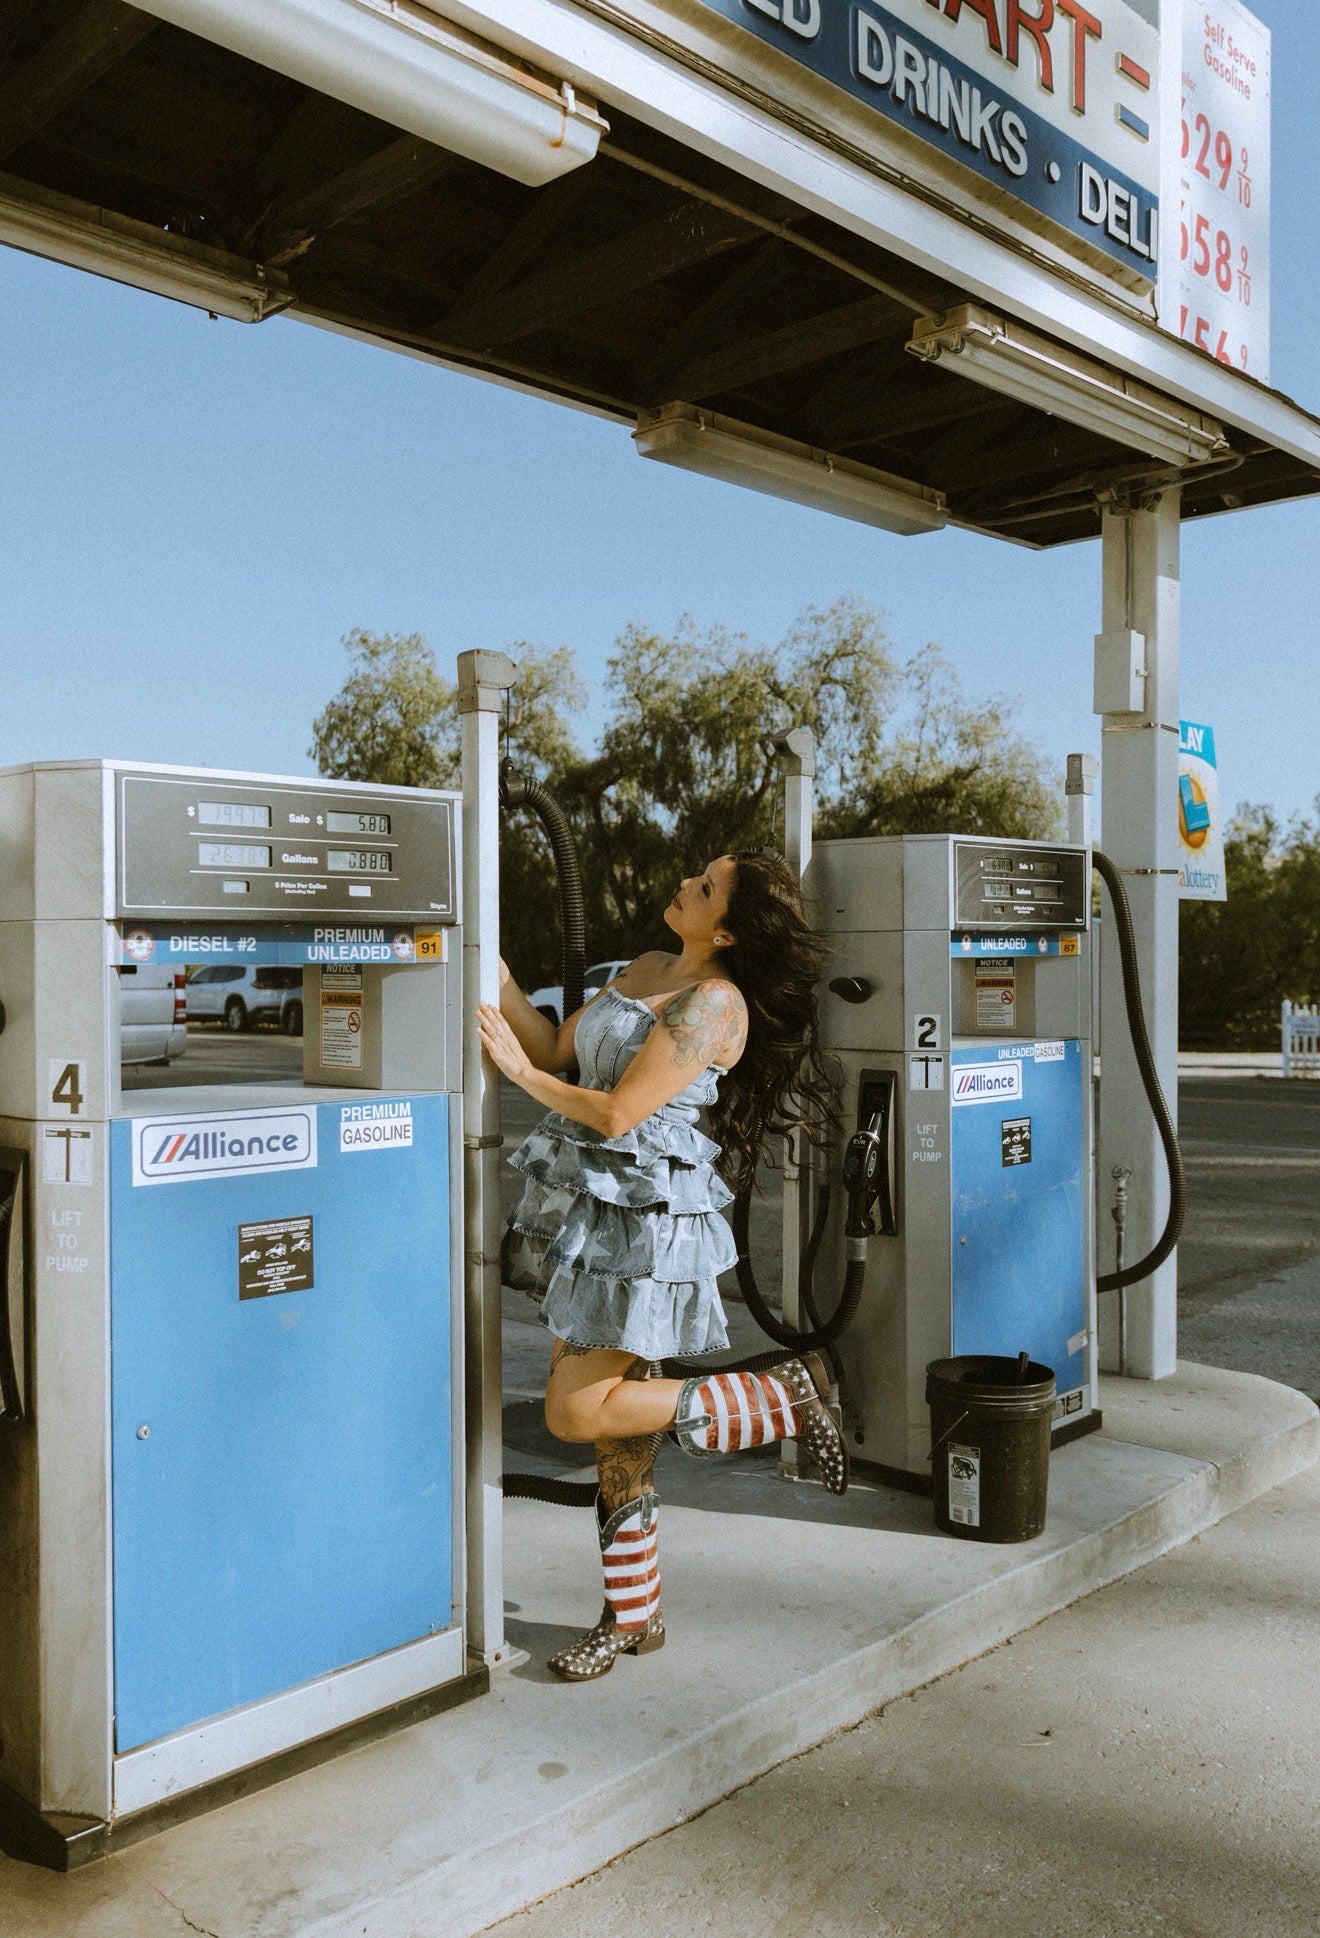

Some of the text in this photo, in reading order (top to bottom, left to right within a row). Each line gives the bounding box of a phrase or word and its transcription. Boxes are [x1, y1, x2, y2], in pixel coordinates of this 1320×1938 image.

[1204, 14, 1256, 77] Self Serve
[924, 0, 1102, 116] RT
[1204, 43, 1251, 100] Gasoline
[857, 9, 1029, 177] DRINKS
[1081, 161, 1158, 263] DELI
[187, 806, 196, 818] $
[288, 813, 324, 825] Sale $
[358, 815, 387, 832] 5.80
[281, 853, 319, 864] Gallons
[349, 853, 388, 870] 0.880
[169, 935, 234, 952] DIESEL
[237, 936, 257, 952] #2
[314, 928, 385, 943] PREMIUM
[421, 942, 437, 954] 91
[980, 938, 1027, 950] UNLEADED
[1063, 944, 1075, 952] 87
[307, 945, 391, 961] UNLEADED
[326, 963, 356, 973] NOTICE
[918, 1016, 937, 1048] 2
[998, 1046, 1034, 1060] UNLEADED
[1035, 1045, 1064, 1058] GASOLINE
[52, 1063, 84, 1115] 4
[967, 1074, 1014, 1093] Alliance
[341, 1102, 411, 1122] PREMIUM
[342, 1124, 411, 1145] GASOLINE
[917, 1124, 939, 1134] LIFT
[177, 1131, 299, 1162] Alliance
[920, 1138, 935, 1148] TO
[912, 1151, 942, 1162] PUMP
[51, 1211, 83, 1227] LIFT
[57, 1233, 78, 1249] TO
[46, 1256, 89, 1274] PUMP
